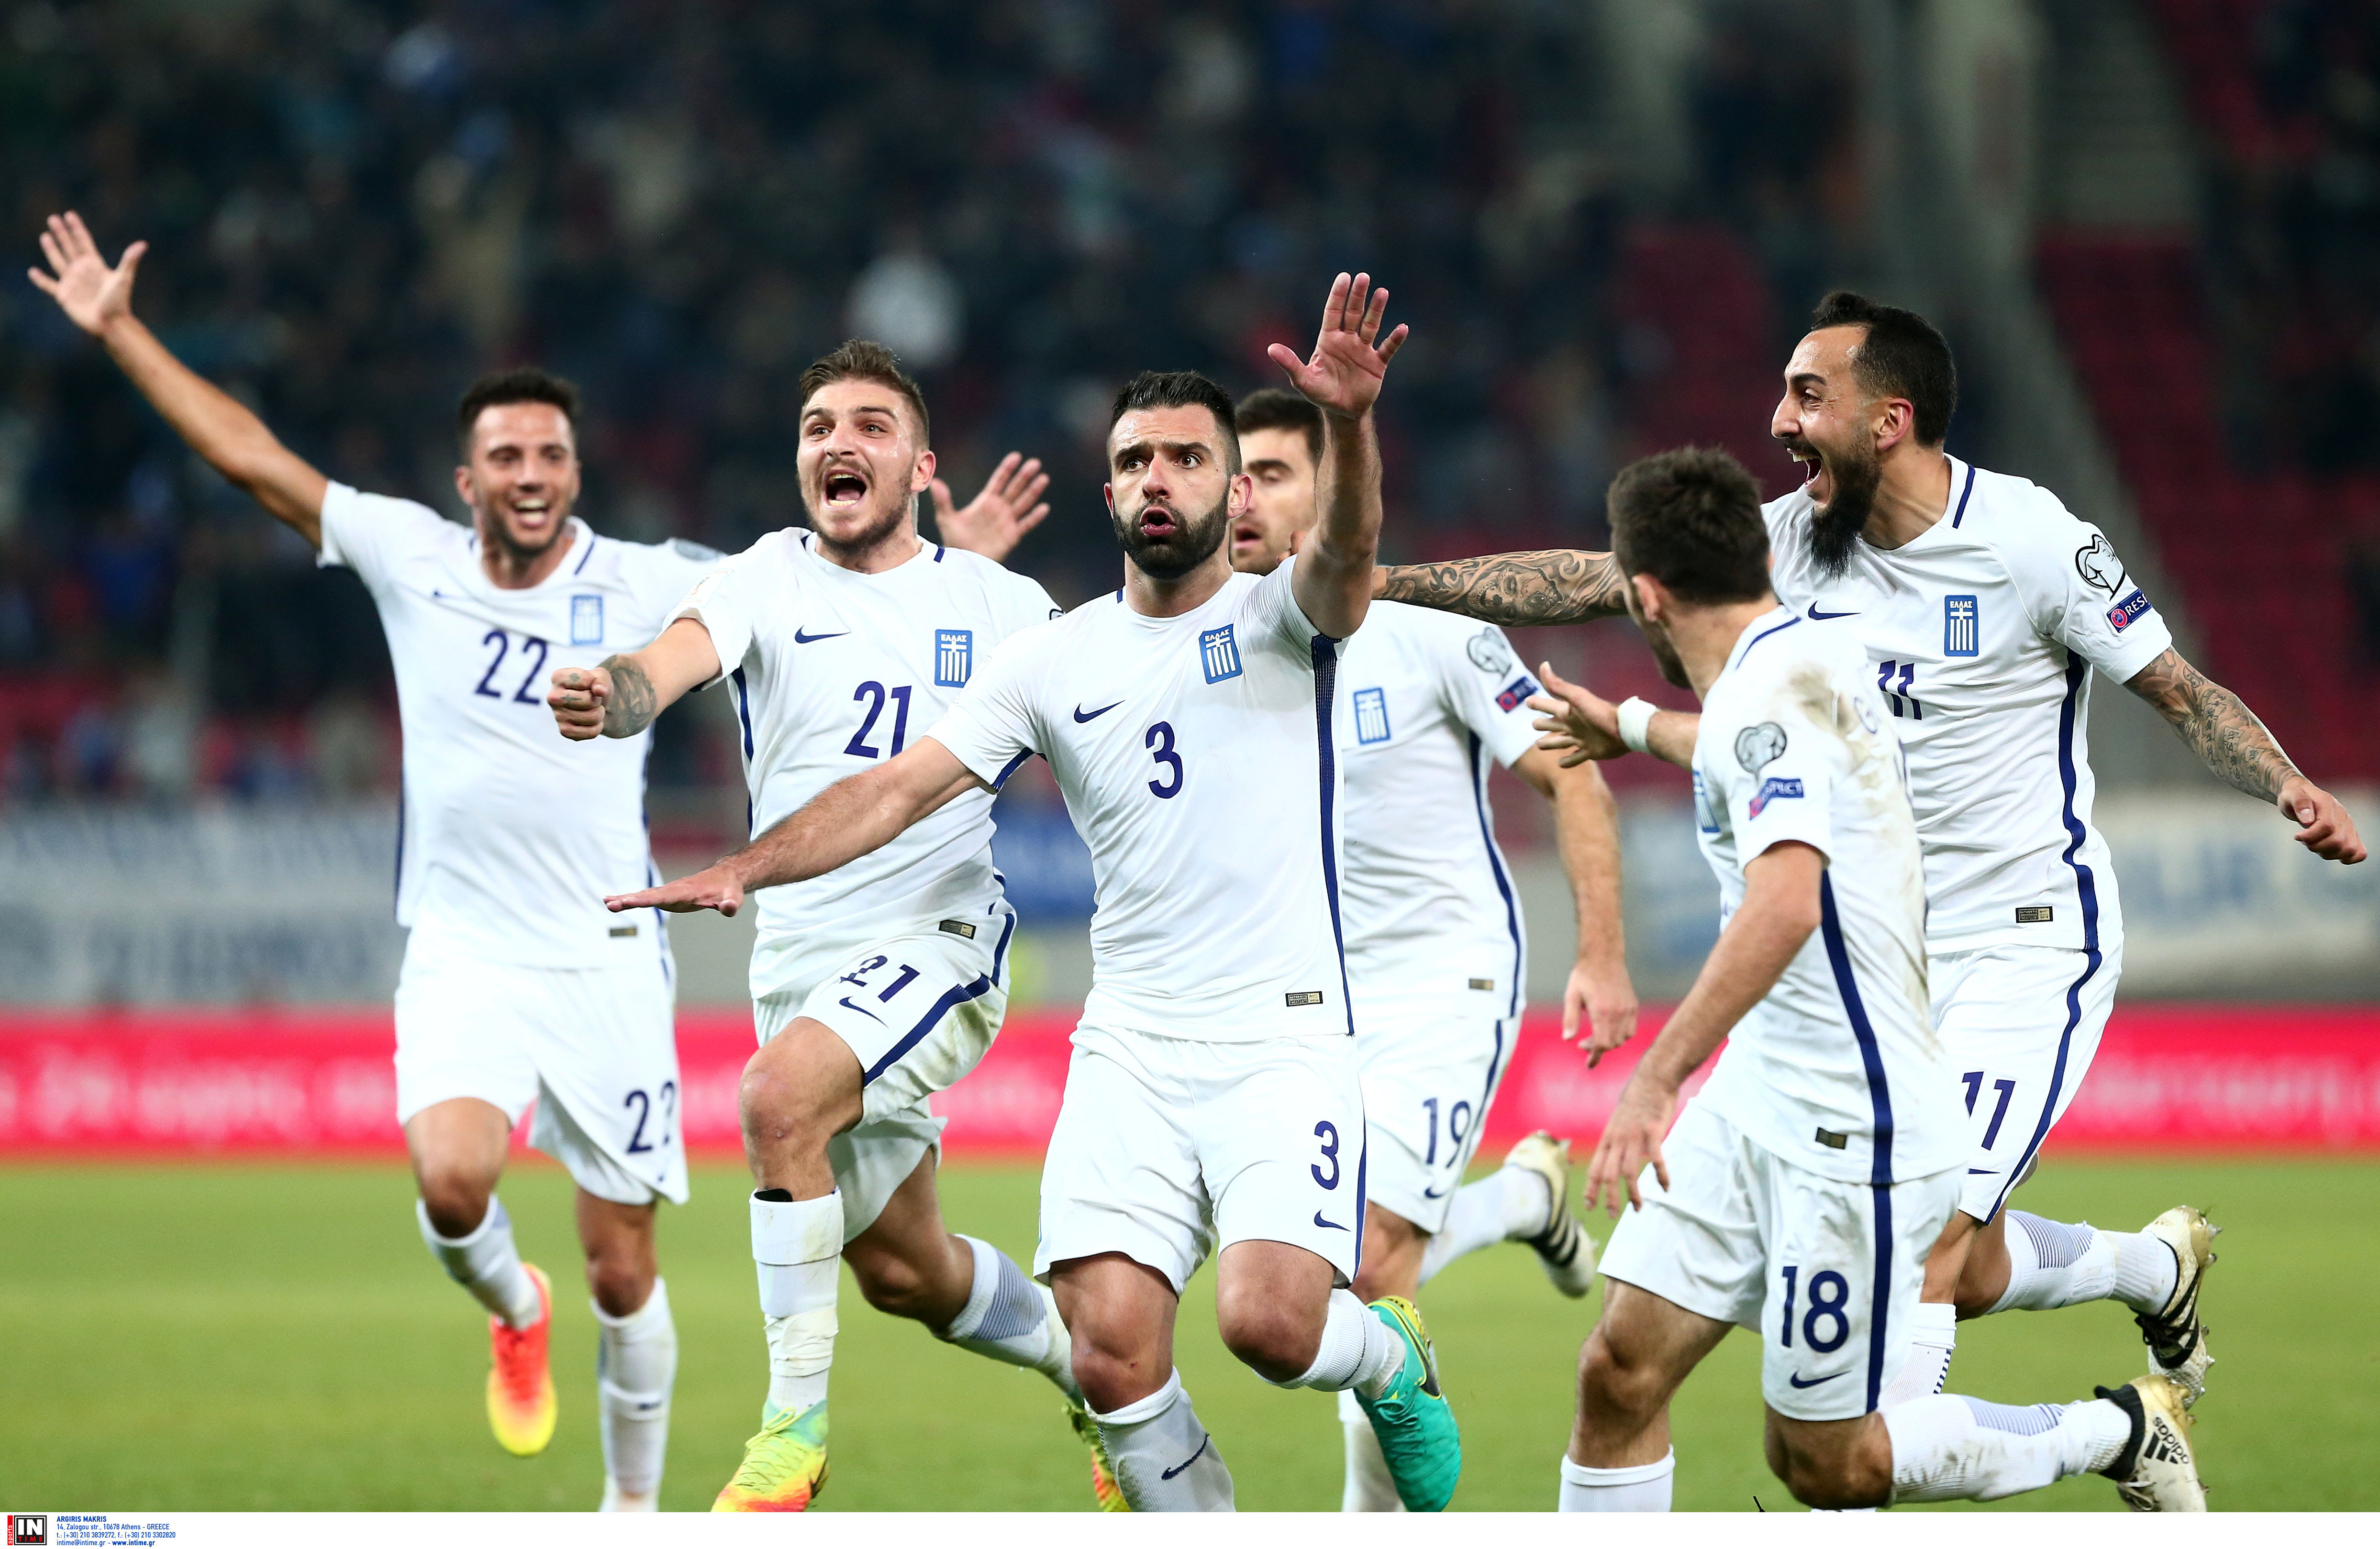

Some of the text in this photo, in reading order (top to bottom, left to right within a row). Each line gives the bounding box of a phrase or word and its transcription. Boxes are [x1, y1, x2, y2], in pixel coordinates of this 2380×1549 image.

[475, 627, 548, 706] 22
[941, 634, 968, 642] ΕΛΛΑΣ
[1205, 629, 1230, 642] ΕΛΛΑΣ
[843, 680, 912, 759] 21
[1878, 660, 1922, 720] 11
[1145, 721, 1183, 799] 3
[839, 955, 921, 1003] 21
[1423, 1098, 1470, 1168] 19
[1961, 1071, 2016, 1151] 11
[1311, 1120, 1340, 1190] 3
[1781, 1266, 1851, 1353] 18
[2154, 1417, 2189, 1464] adidas
